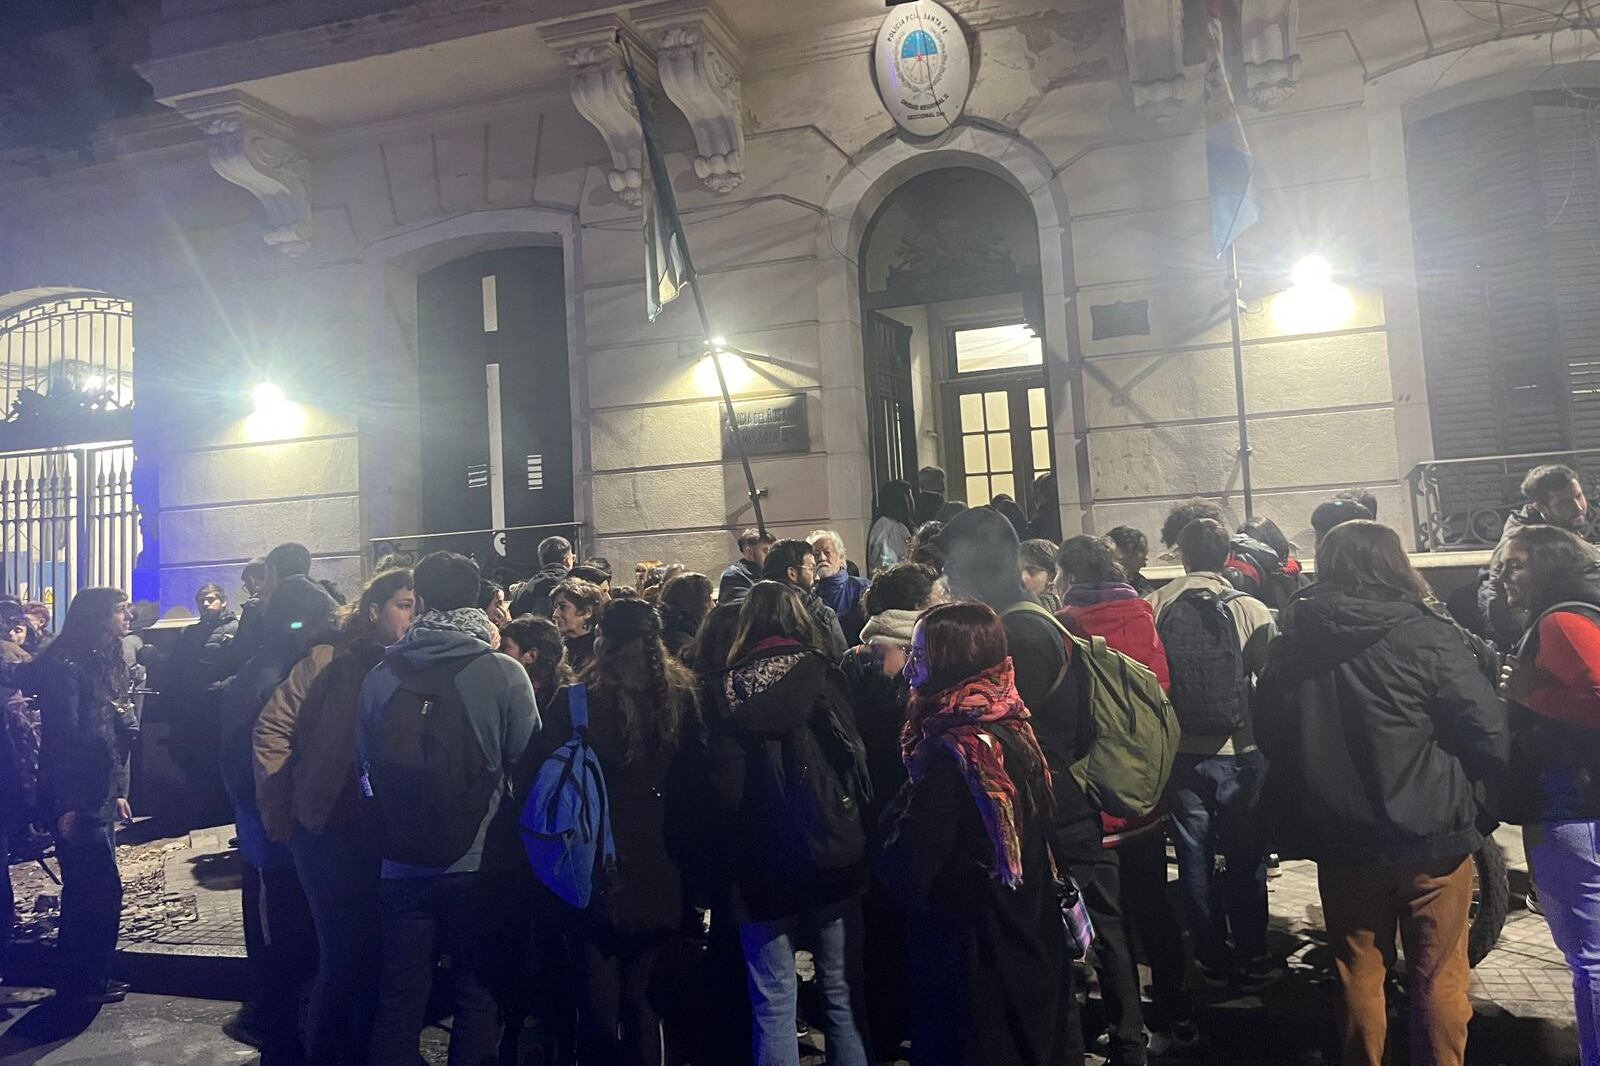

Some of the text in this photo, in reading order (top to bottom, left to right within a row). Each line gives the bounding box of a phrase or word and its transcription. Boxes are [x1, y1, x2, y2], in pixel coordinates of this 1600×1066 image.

[888, 20, 906, 42] POLICIA
[923, 13, 942, 27] SANTA
[940, 25, 949, 35] FE
